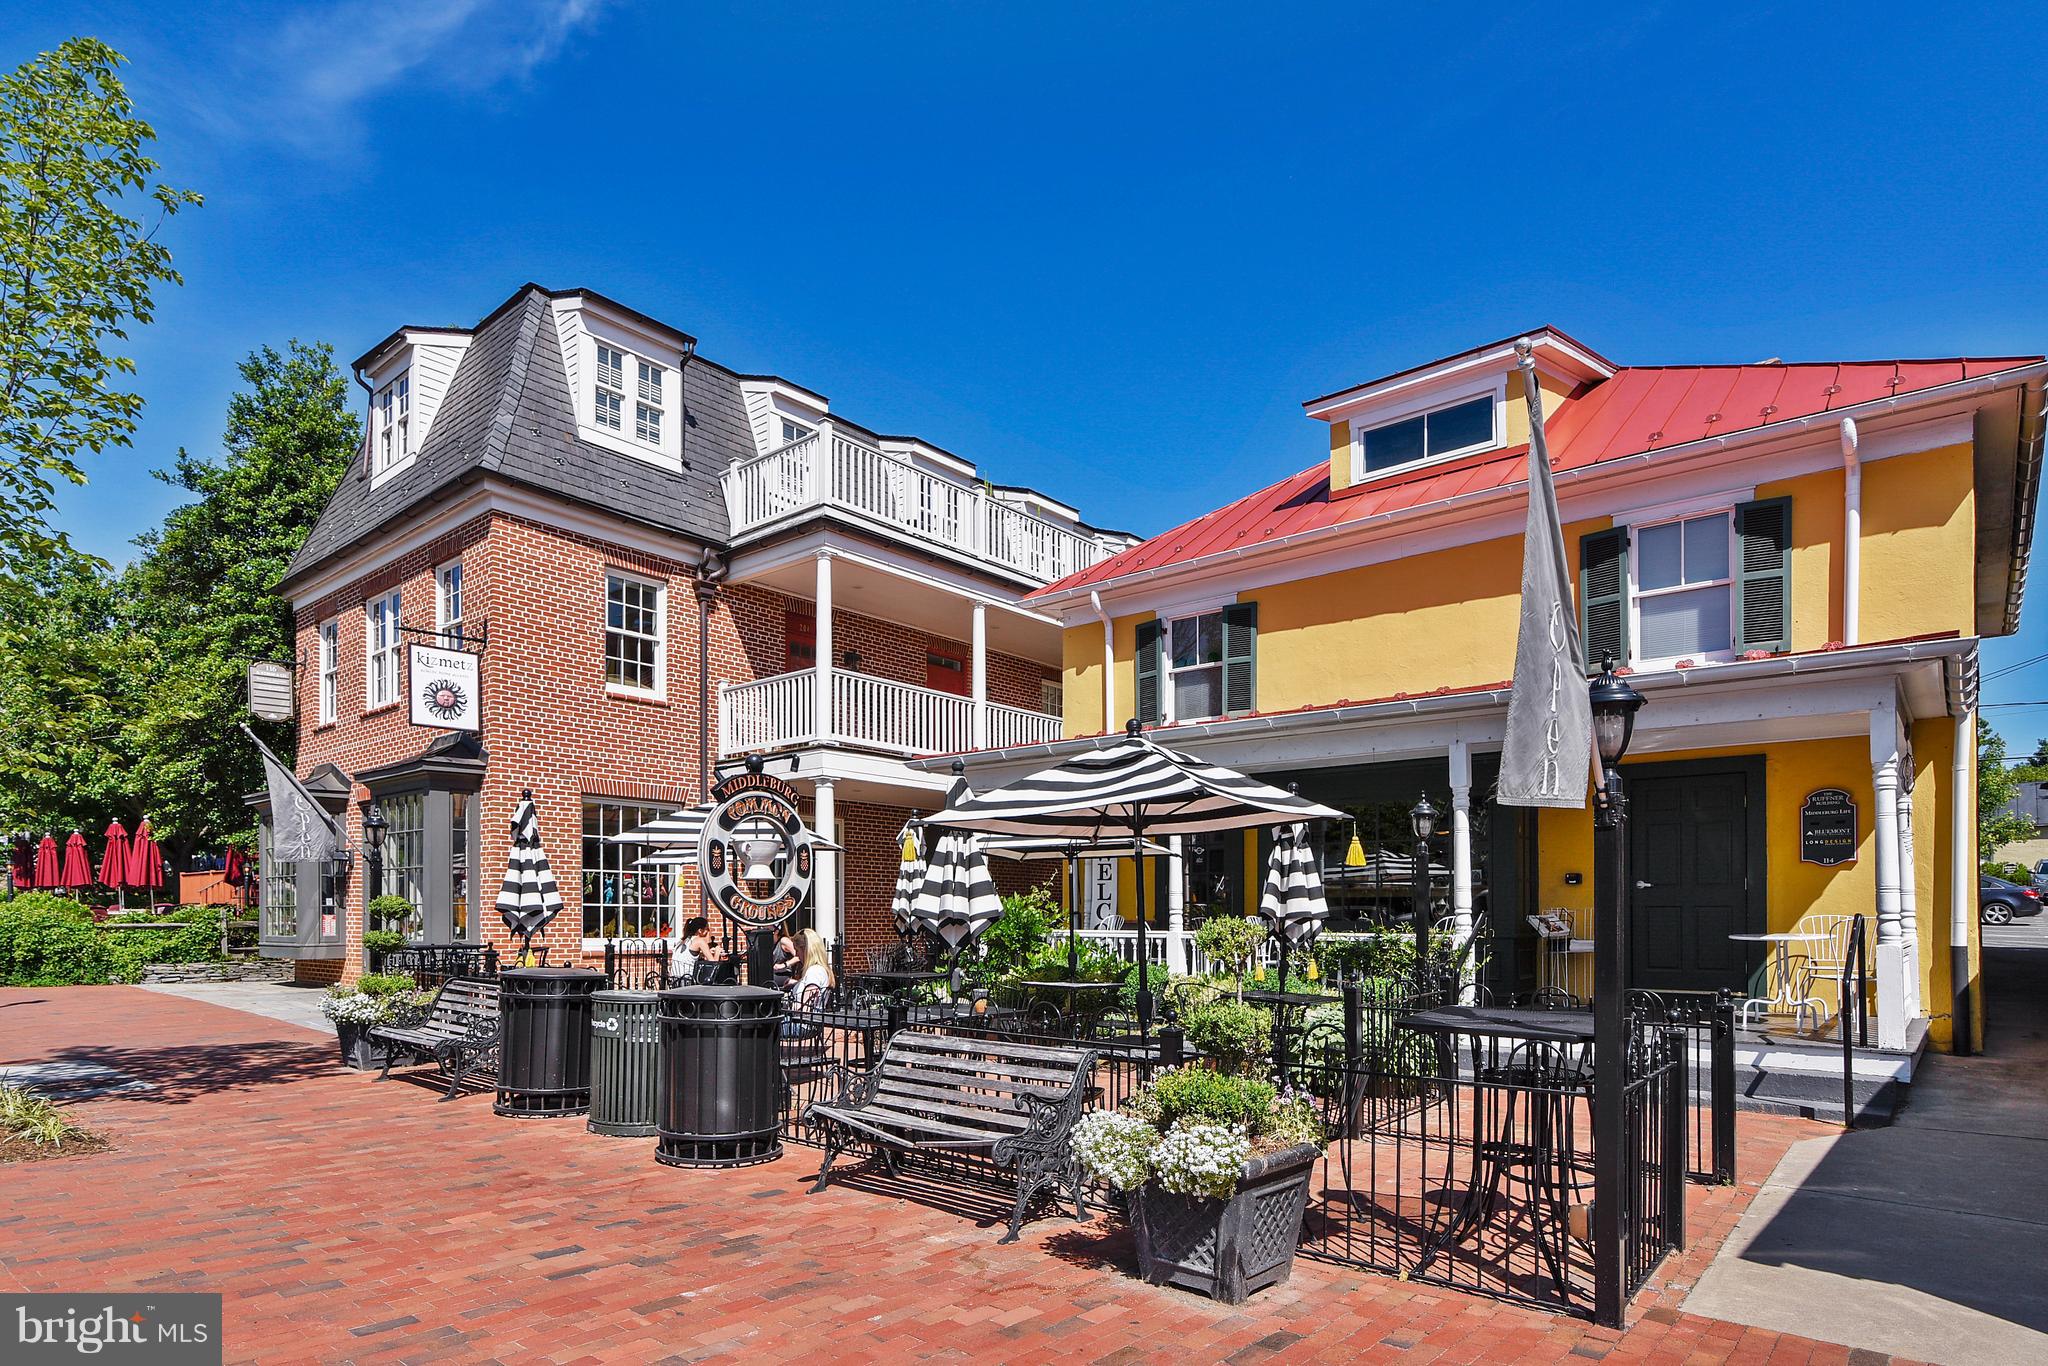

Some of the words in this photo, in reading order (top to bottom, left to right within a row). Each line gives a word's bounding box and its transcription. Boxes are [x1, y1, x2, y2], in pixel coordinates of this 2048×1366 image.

[417, 652, 474, 672] kizmetz
[1541, 600, 1566, 796] Open
[721, 775, 800, 806] MIDDLEBURG
[294, 793, 312, 858] Open
[730, 893, 796, 920] GROUNDS
